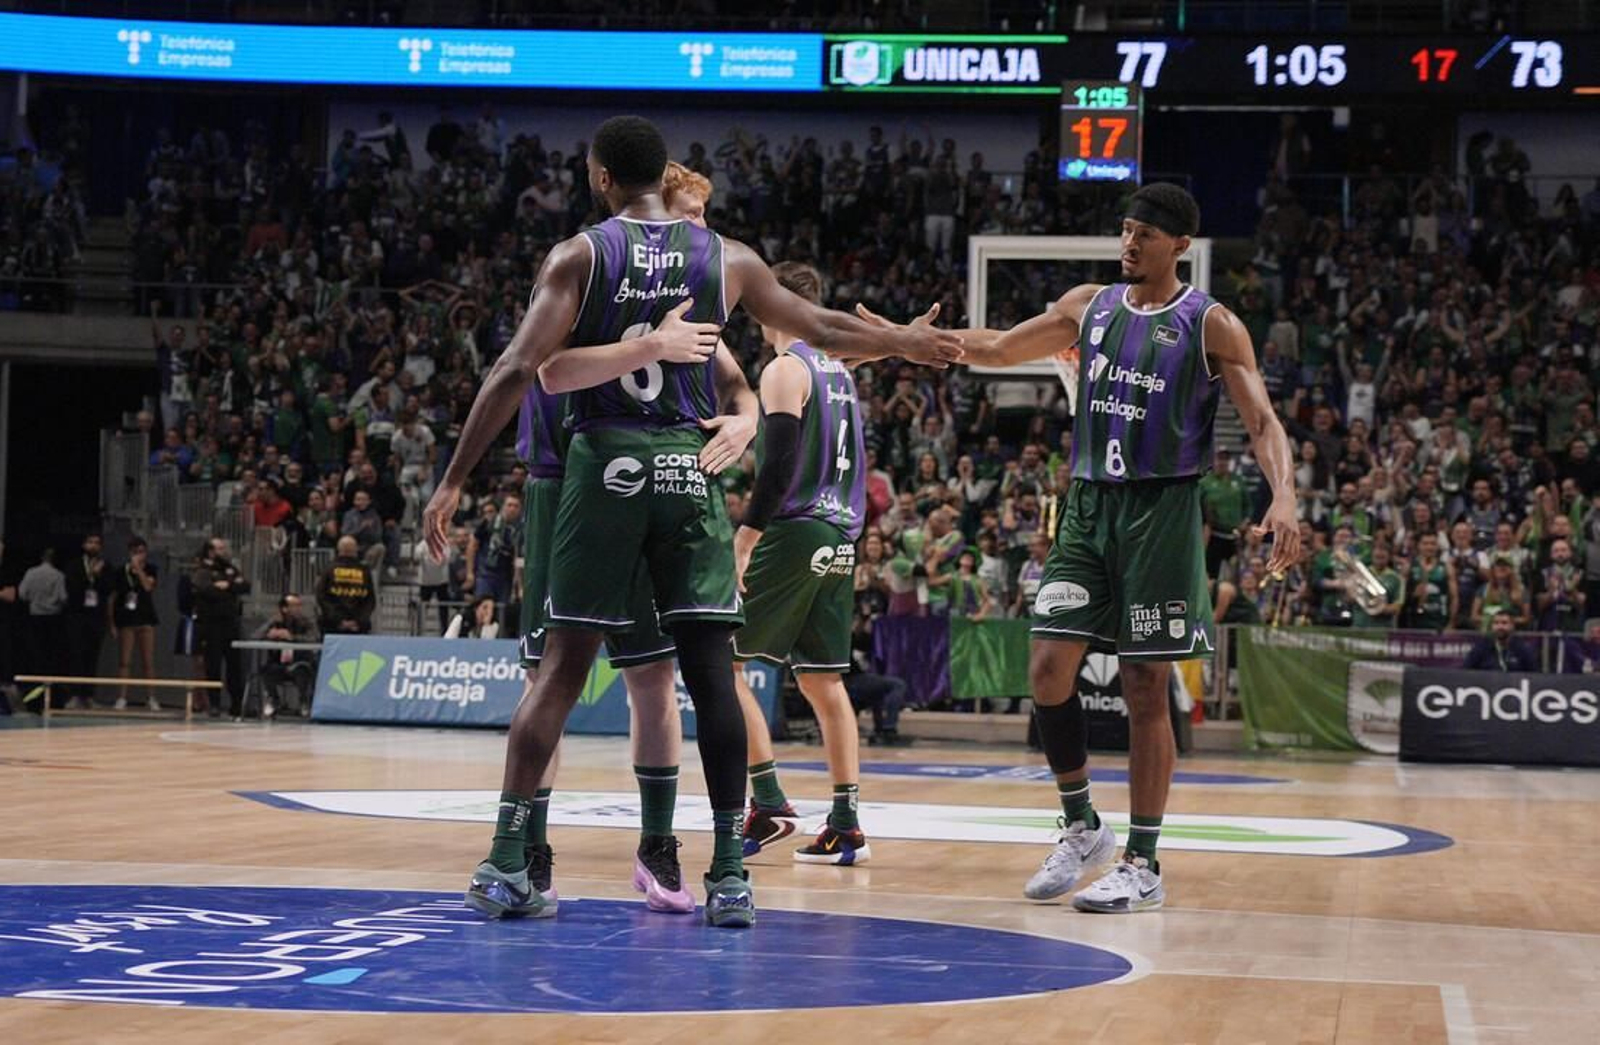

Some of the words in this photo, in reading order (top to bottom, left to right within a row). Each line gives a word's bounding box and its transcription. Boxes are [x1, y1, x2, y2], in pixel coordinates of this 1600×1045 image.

[158, 50, 232, 68] Empresas
[439, 58, 512, 75] Empresas
[720, 62, 795, 79] Empresas
[903, 48, 1040, 82] UNICAJA
[1117, 42, 1167, 87] 77
[1246, 45, 1347, 86] 1:05
[1411, 49, 1458, 82] 17
[1510, 41, 1563, 87] 73
[1073, 86, 1129, 108] 1:05
[1071, 117, 1129, 158] 17
[633, 243, 684, 276] Ejim
[1108, 364, 1166, 394] Unicaja
[654, 453, 699, 469] COST
[836, 418, 851, 482] 4
[654, 469, 684, 481] DEL
[654, 481, 707, 498] MÁLAGA
[1131, 617, 1162, 636] laga
[391, 655, 526, 681] Fundación
[389, 678, 486, 707] Unicaja
[14, 900, 487, 1006] GUERÓN
